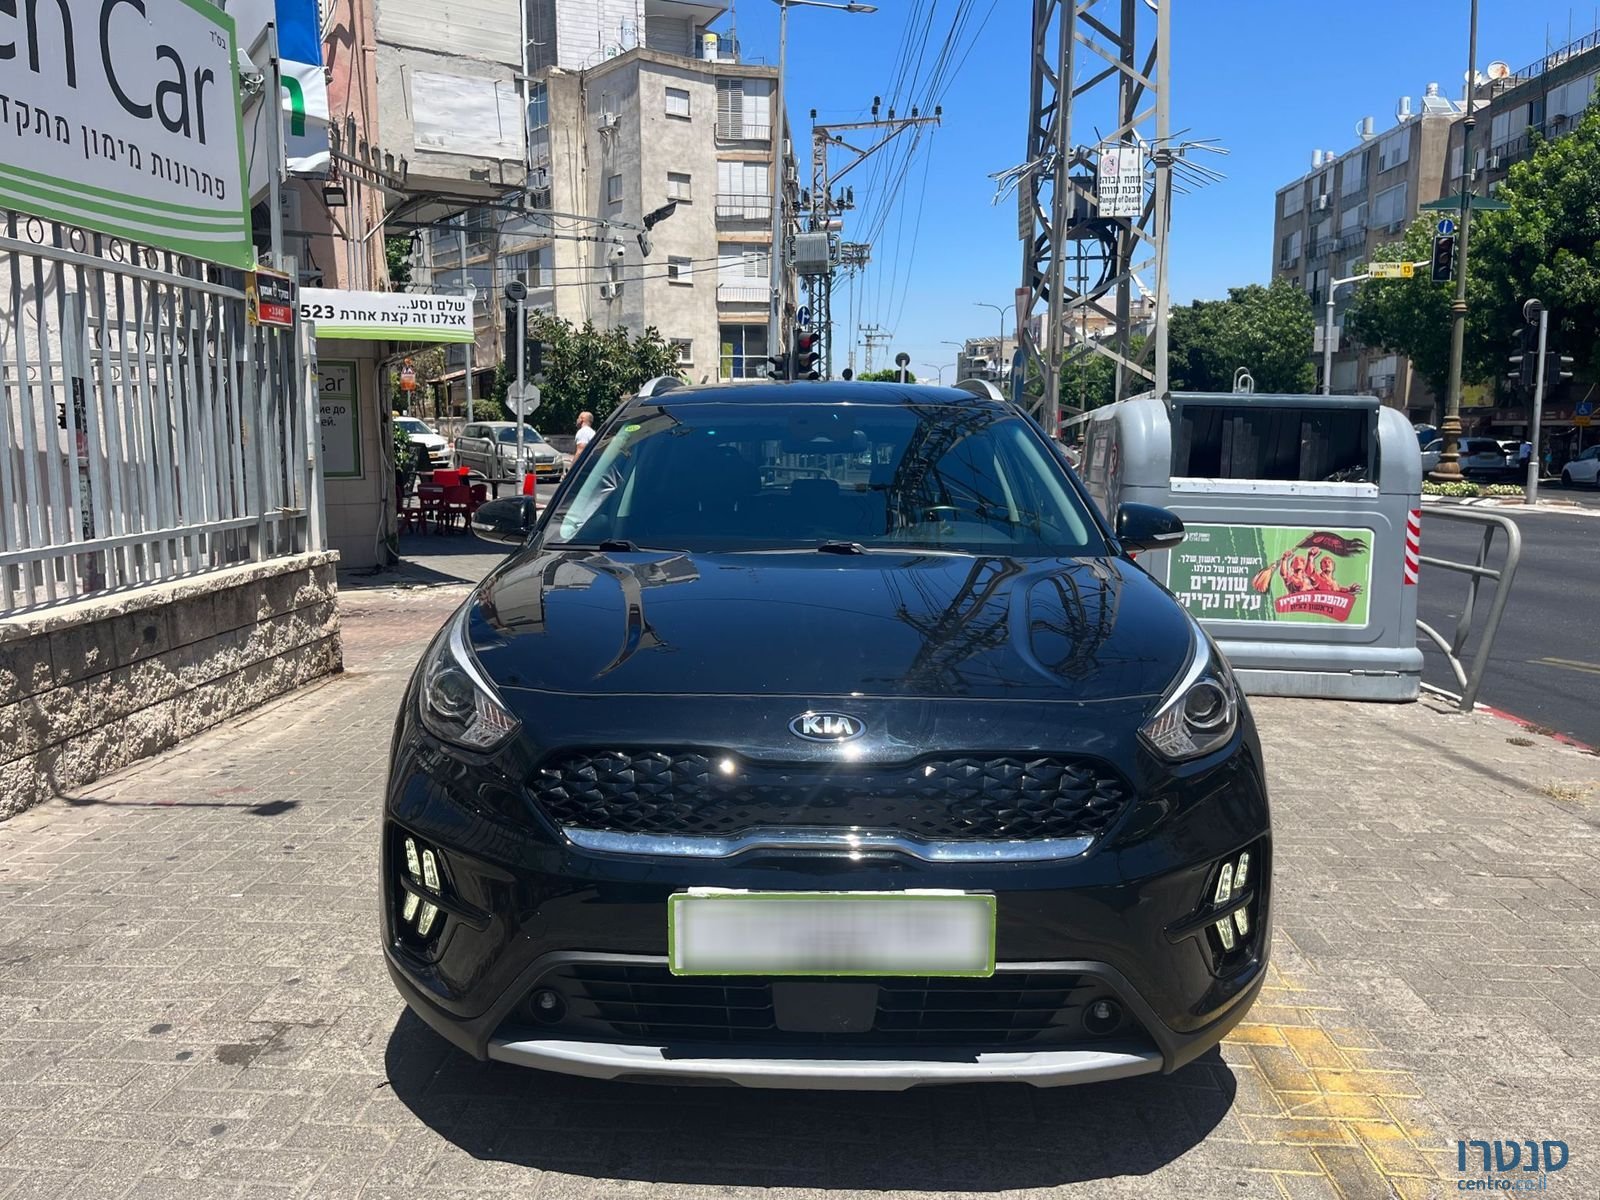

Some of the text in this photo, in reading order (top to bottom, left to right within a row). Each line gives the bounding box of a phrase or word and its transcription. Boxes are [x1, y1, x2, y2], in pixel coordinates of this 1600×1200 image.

[100, 0, 214, 145] Car
[81, 125, 141, 170] מימון
[151, 152, 225, 200] פתרונות
[1124, 175, 1141, 184] מתח
[1122, 186, 1141, 194] סכנת
[300, 305, 335, 319] 523
[398, 300, 465, 311] שלם וסע...
[340, 310, 466, 325] אצלנו זה קצת אחרת
[333, 406, 346, 416] до
[1198, 555, 1221, 564] ראשון
[1240, 557, 1262, 565] ראשון
[1213, 564, 1225, 573] של
[1226, 565, 1249, 575] ראשון
[1190, 575, 1249, 592] שומרים
[1223, 592, 1262, 611] עליה
[1313, 594, 1349, 608] מהפכת
[803, 716, 853, 734] KIA
